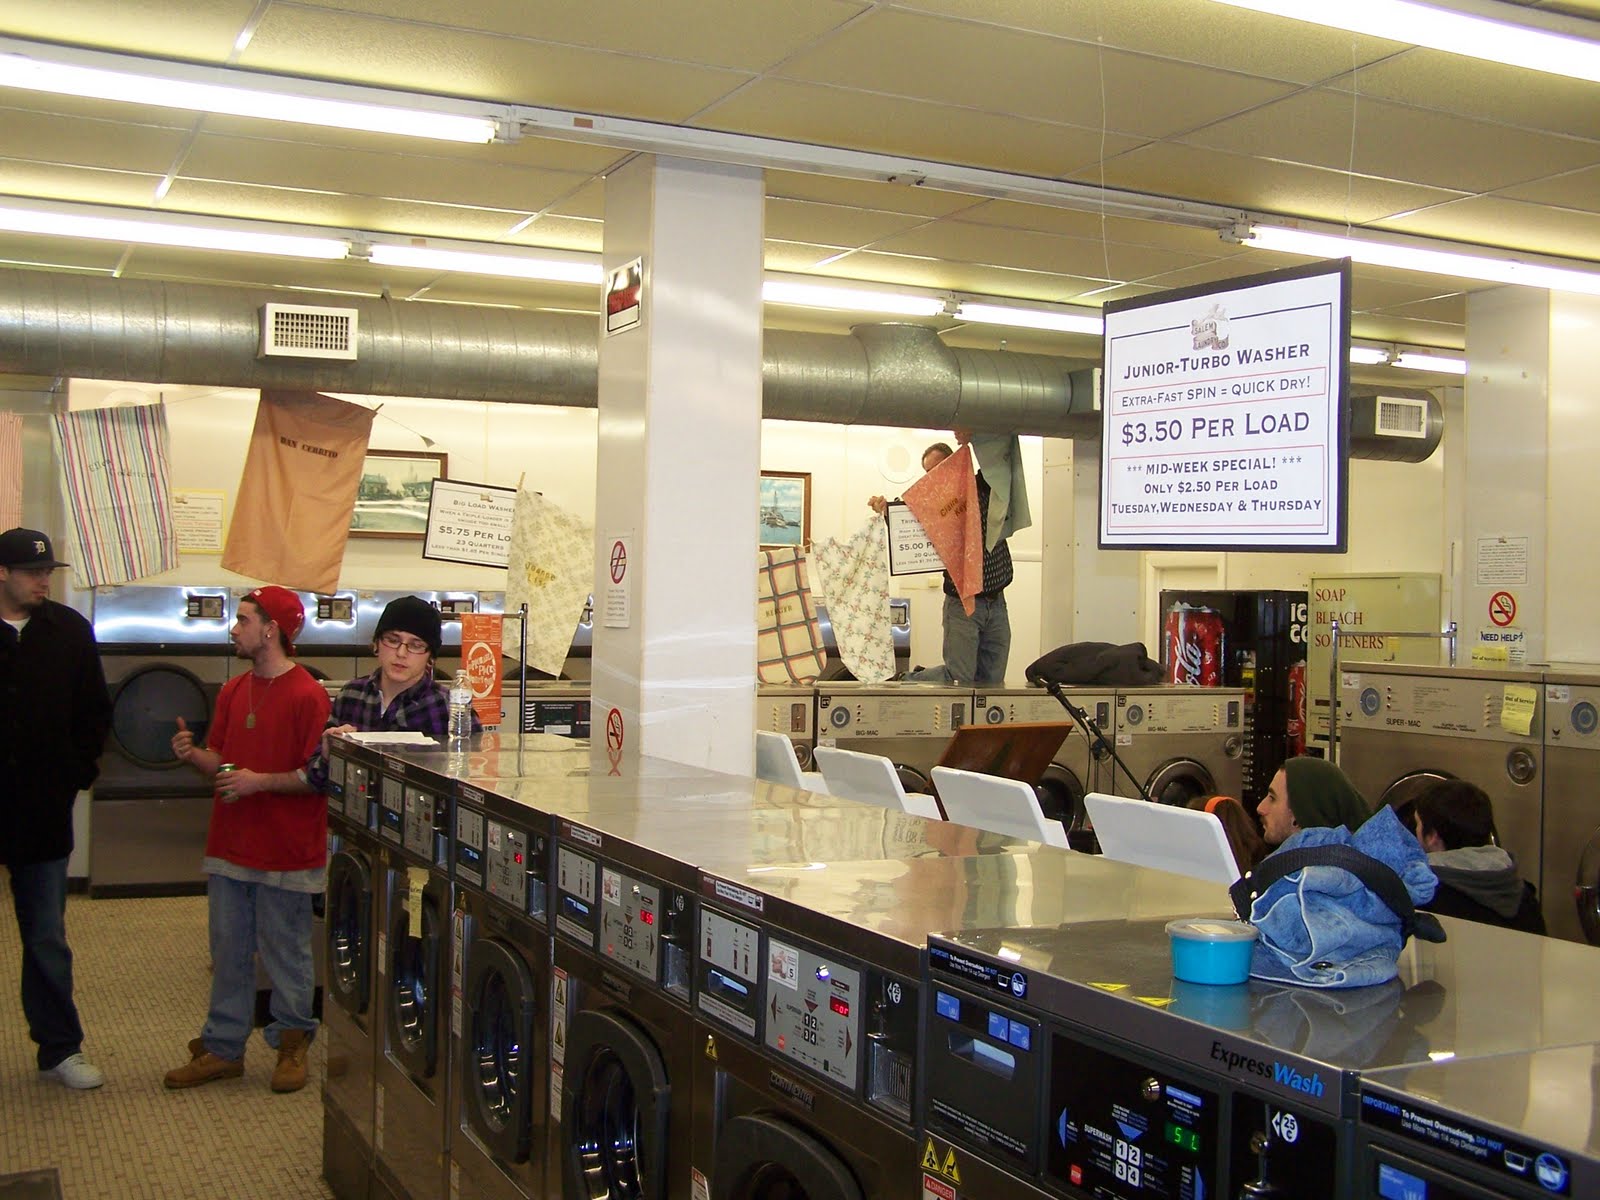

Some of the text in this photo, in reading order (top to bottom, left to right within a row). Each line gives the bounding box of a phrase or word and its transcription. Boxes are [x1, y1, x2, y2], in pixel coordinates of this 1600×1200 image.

[1123, 343, 1310, 379] JUNIOR-TURBO WASHER
[1122, 391, 1183, 407] EXTRA-FAST
[1187, 387, 1216, 400] SPIN
[1231, 380, 1275, 395] QUICK
[1280, 376, 1310, 391] DRY!
[1122, 412, 1310, 447] $3.50 PER LOAD
[1146, 457, 1276, 475] MID-WEEK SPECIAL!
[1144, 479, 1278, 494] ONLY $2.50 PER LOAD
[468, 501, 486, 509] LOAD
[1238, 500, 1247, 512] &
[1251, 499, 1321, 512] THURSDAY
[439, 526, 512, 542] $5.75 PER LO
[468, 541, 504, 550] QUARTERS
[899, 542, 923, 551] $5.00
[1315, 588, 1346, 602] SOAP
[1291, 602, 1307, 622] IC
[1316, 611, 1363, 625] BLEACH
[1290, 624, 1308, 643] CO
[1480, 631, 1523, 642] NEED HELP?
[1315, 634, 1384, 649] SOTENERS
[789, 968, 794, 978] 5
[1283, 1117, 1296, 1130] 25
[1401, 1118, 1412, 1129] Use
[1412, 1122, 1426, 1134] More
[1426, 1127, 1440, 1138] Than
[1402, 1109, 1410, 1118] To
[1410, 1112, 1433, 1128] Prevent
[1476, 1135, 1486, 1146] DO
[1084, 1123, 1113, 1143] SUPERWASH
[1131, 1149, 1138, 1162] 2
[1118, 1163, 1137, 1183] 3 4
[930, 1182, 953, 1199] DANGER
